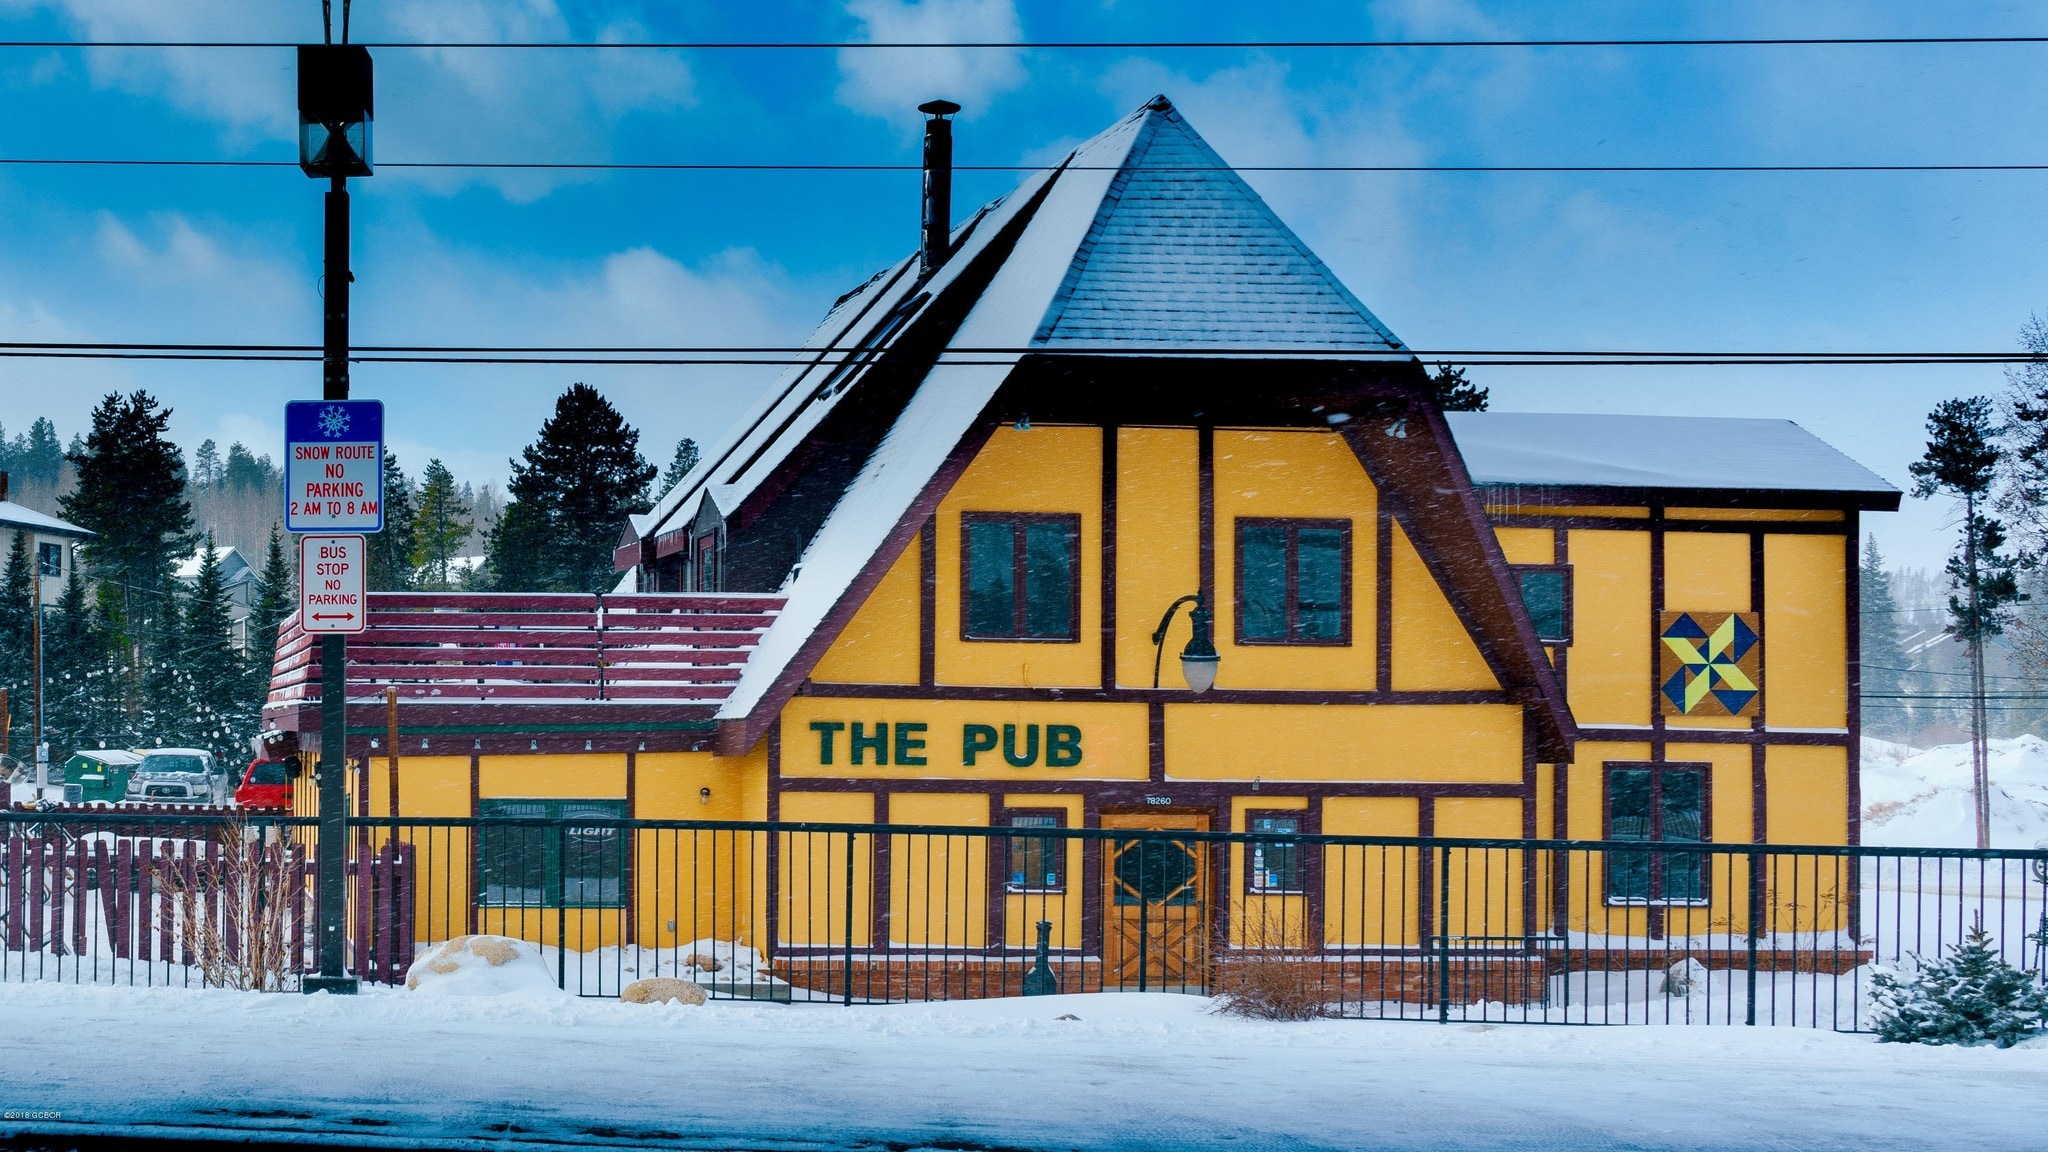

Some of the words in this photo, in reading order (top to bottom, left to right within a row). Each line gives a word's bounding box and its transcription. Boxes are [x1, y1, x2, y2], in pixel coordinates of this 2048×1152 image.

[295, 446, 330, 460] SNOW
[335, 445, 375, 459] ROUTE
[325, 463, 344, 478] NO
[306, 482, 364, 497] PARKING
[290, 502, 298, 515] 2
[303, 502, 321, 515] AM
[327, 501, 341, 515] TO
[347, 501, 354, 515] 8
[360, 501, 378, 514] AM
[320, 546, 346, 558] BUS
[316, 563, 349, 575] STOP
[325, 580, 341, 590] NO
[308, 594, 357, 605] PARKING
[809, 721, 928, 766] THE
[962, 723, 1083, 768] PUB
[1146, 797, 1172, 805] 78260
[568, 827, 617, 836] LIGHT
